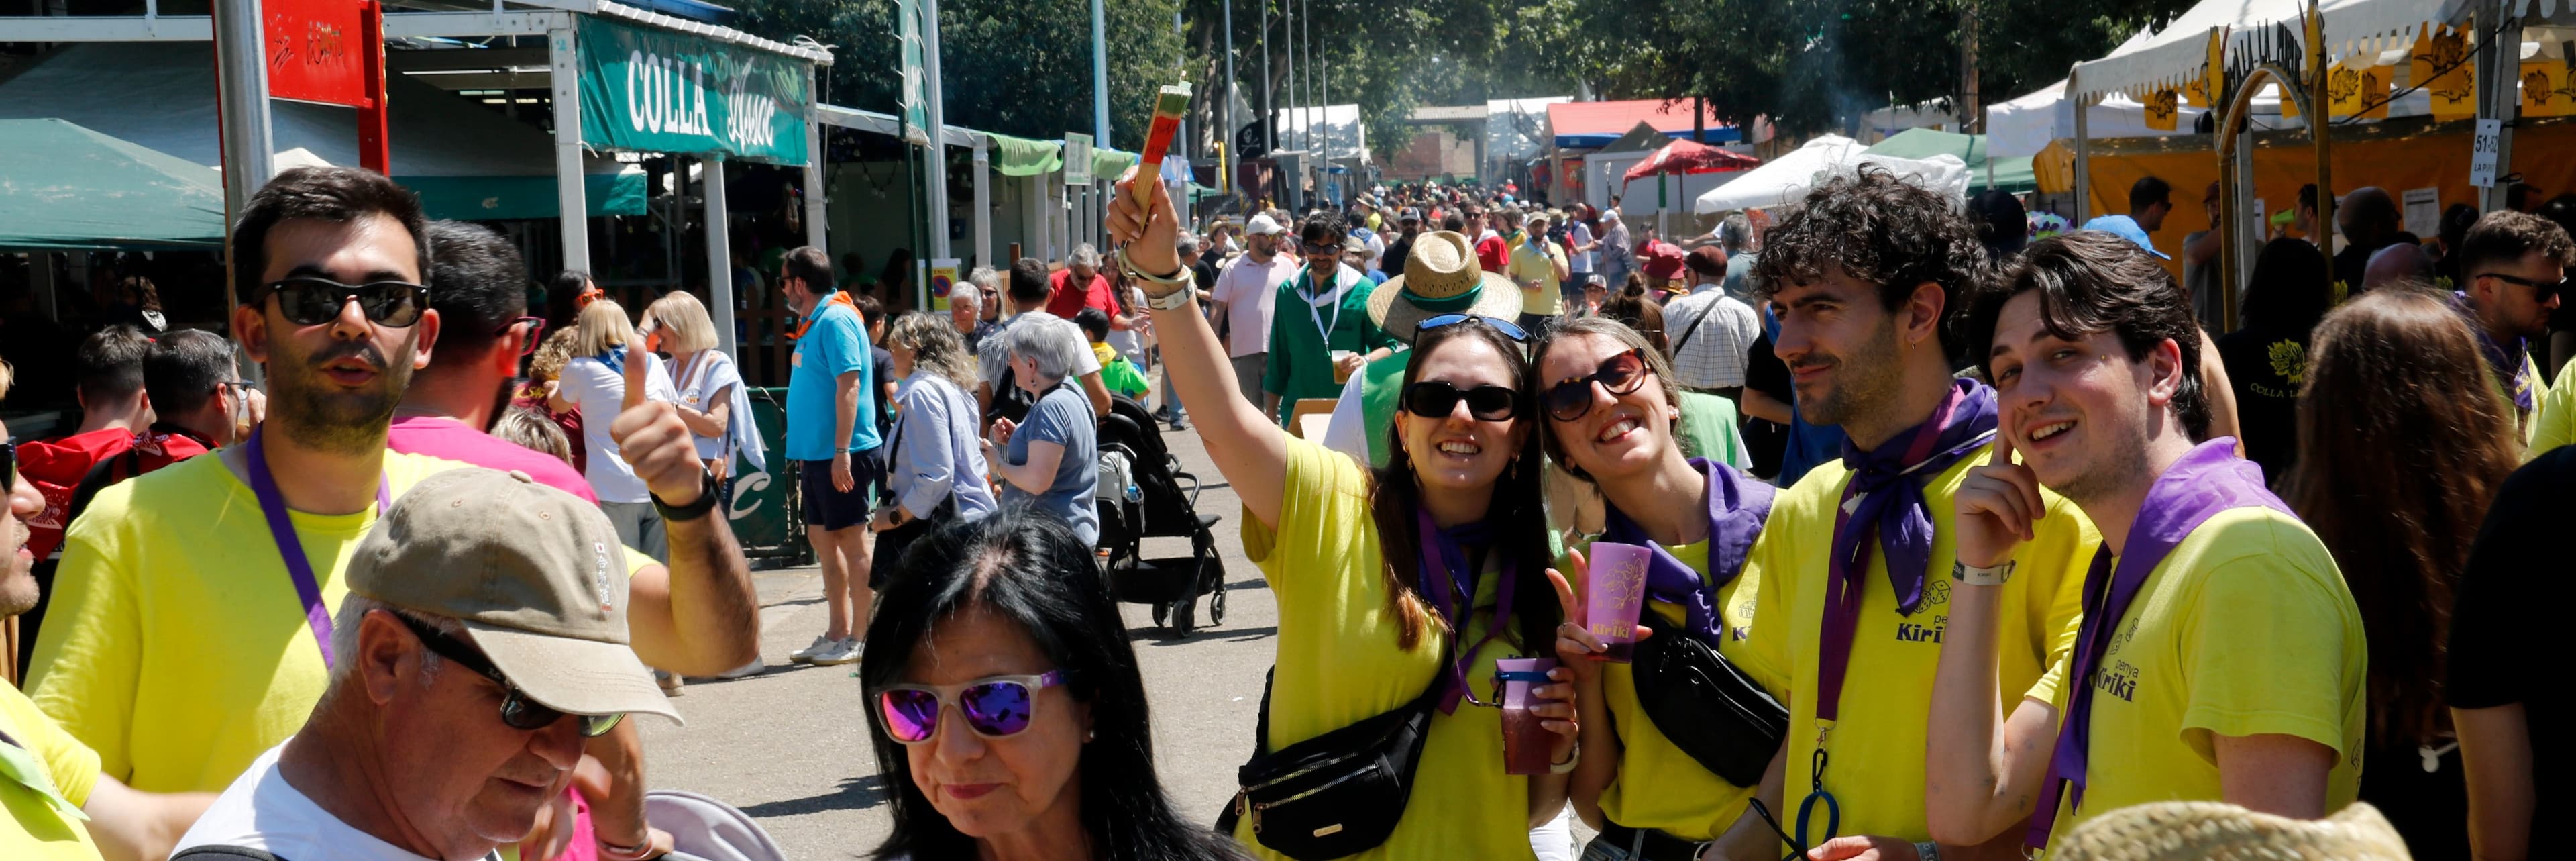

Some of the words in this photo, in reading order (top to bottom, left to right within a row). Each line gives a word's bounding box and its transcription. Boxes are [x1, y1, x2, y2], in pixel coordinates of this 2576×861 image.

[627, 49, 712, 136] COLLA
[2250, 383, 2284, 398] COLLA
[1896, 623, 1945, 644] Kiri
[2115, 659, 2139, 679] penya
